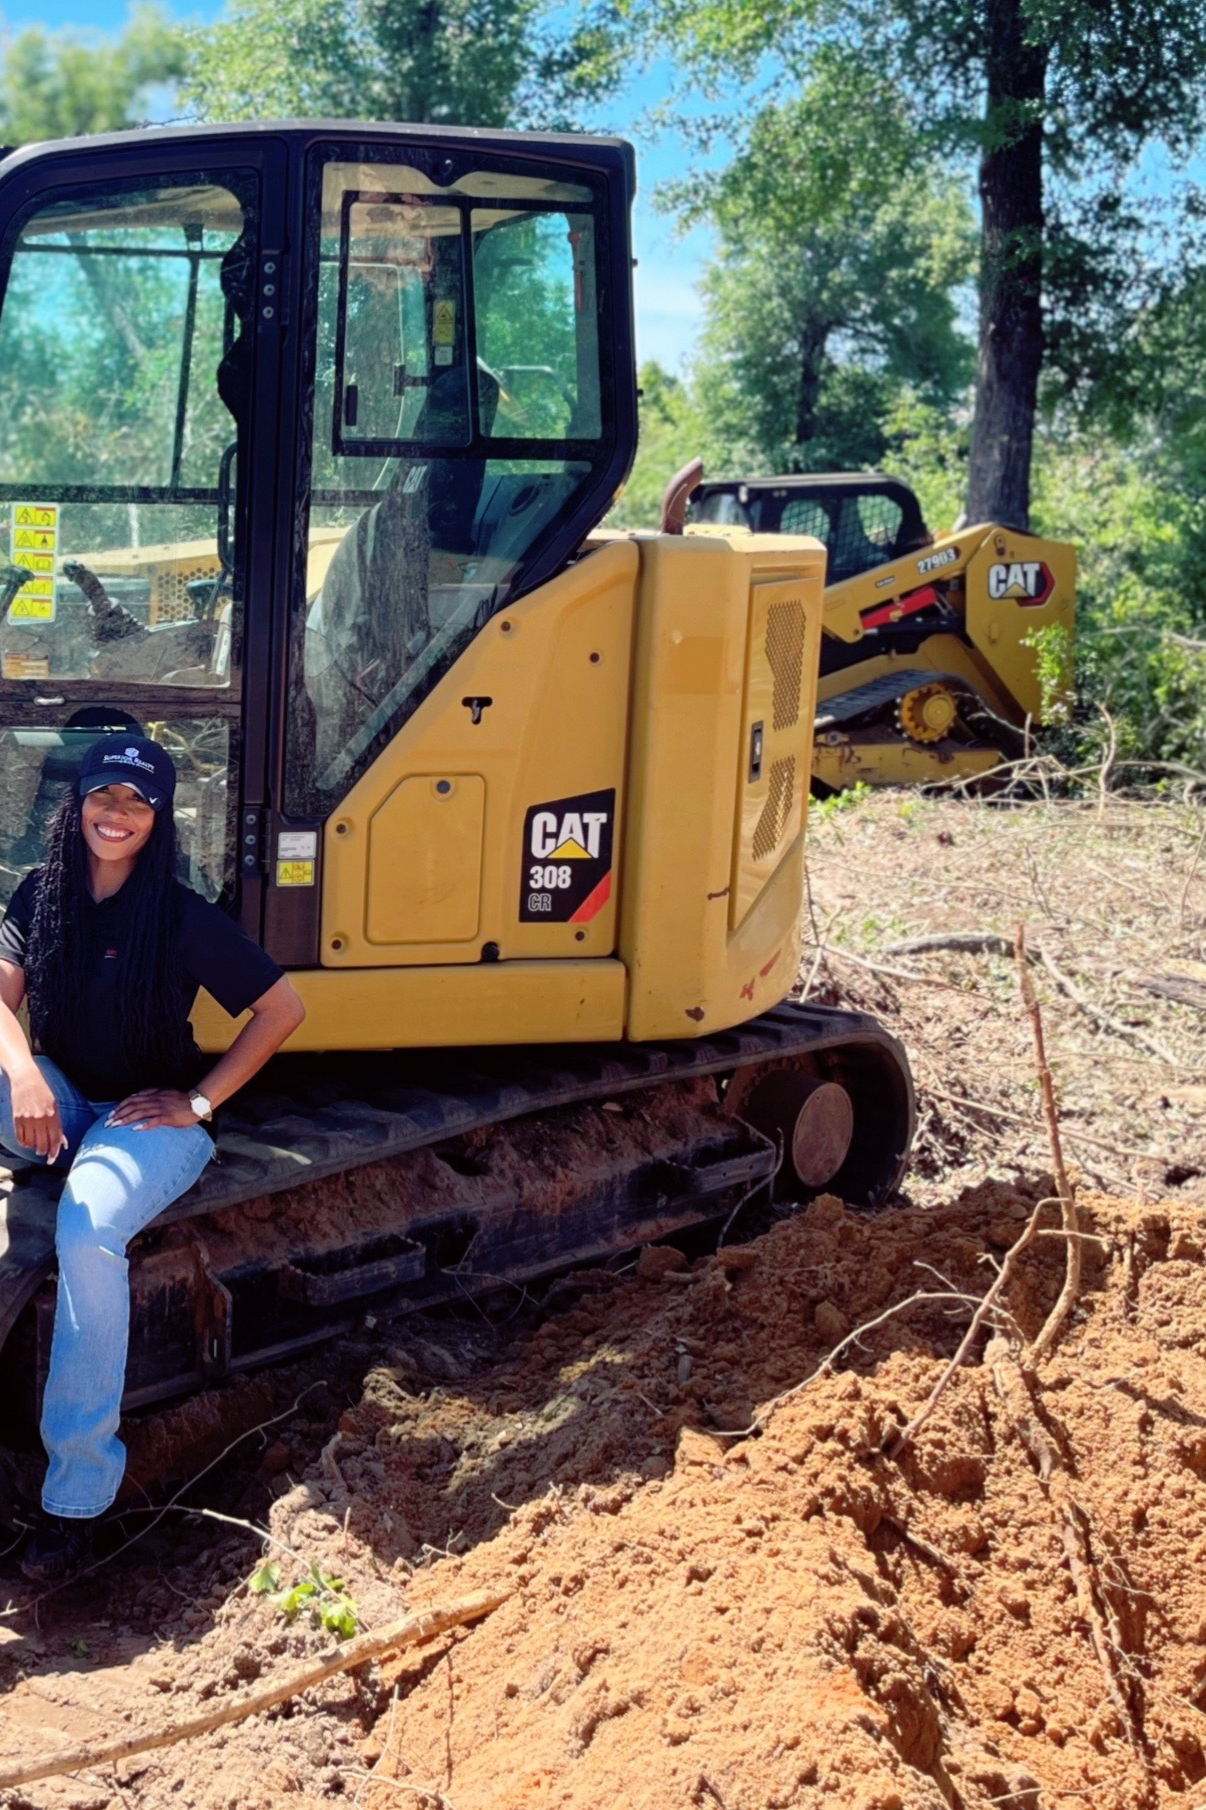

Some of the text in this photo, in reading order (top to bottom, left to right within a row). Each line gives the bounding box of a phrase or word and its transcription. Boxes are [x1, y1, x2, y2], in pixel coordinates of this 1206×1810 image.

[916, 548, 957, 574] 279D3
[988, 562, 1041, 599] CAT
[531, 812, 608, 859] CAT
[529, 865, 572, 889] 308
[527, 893, 552, 911] CR
